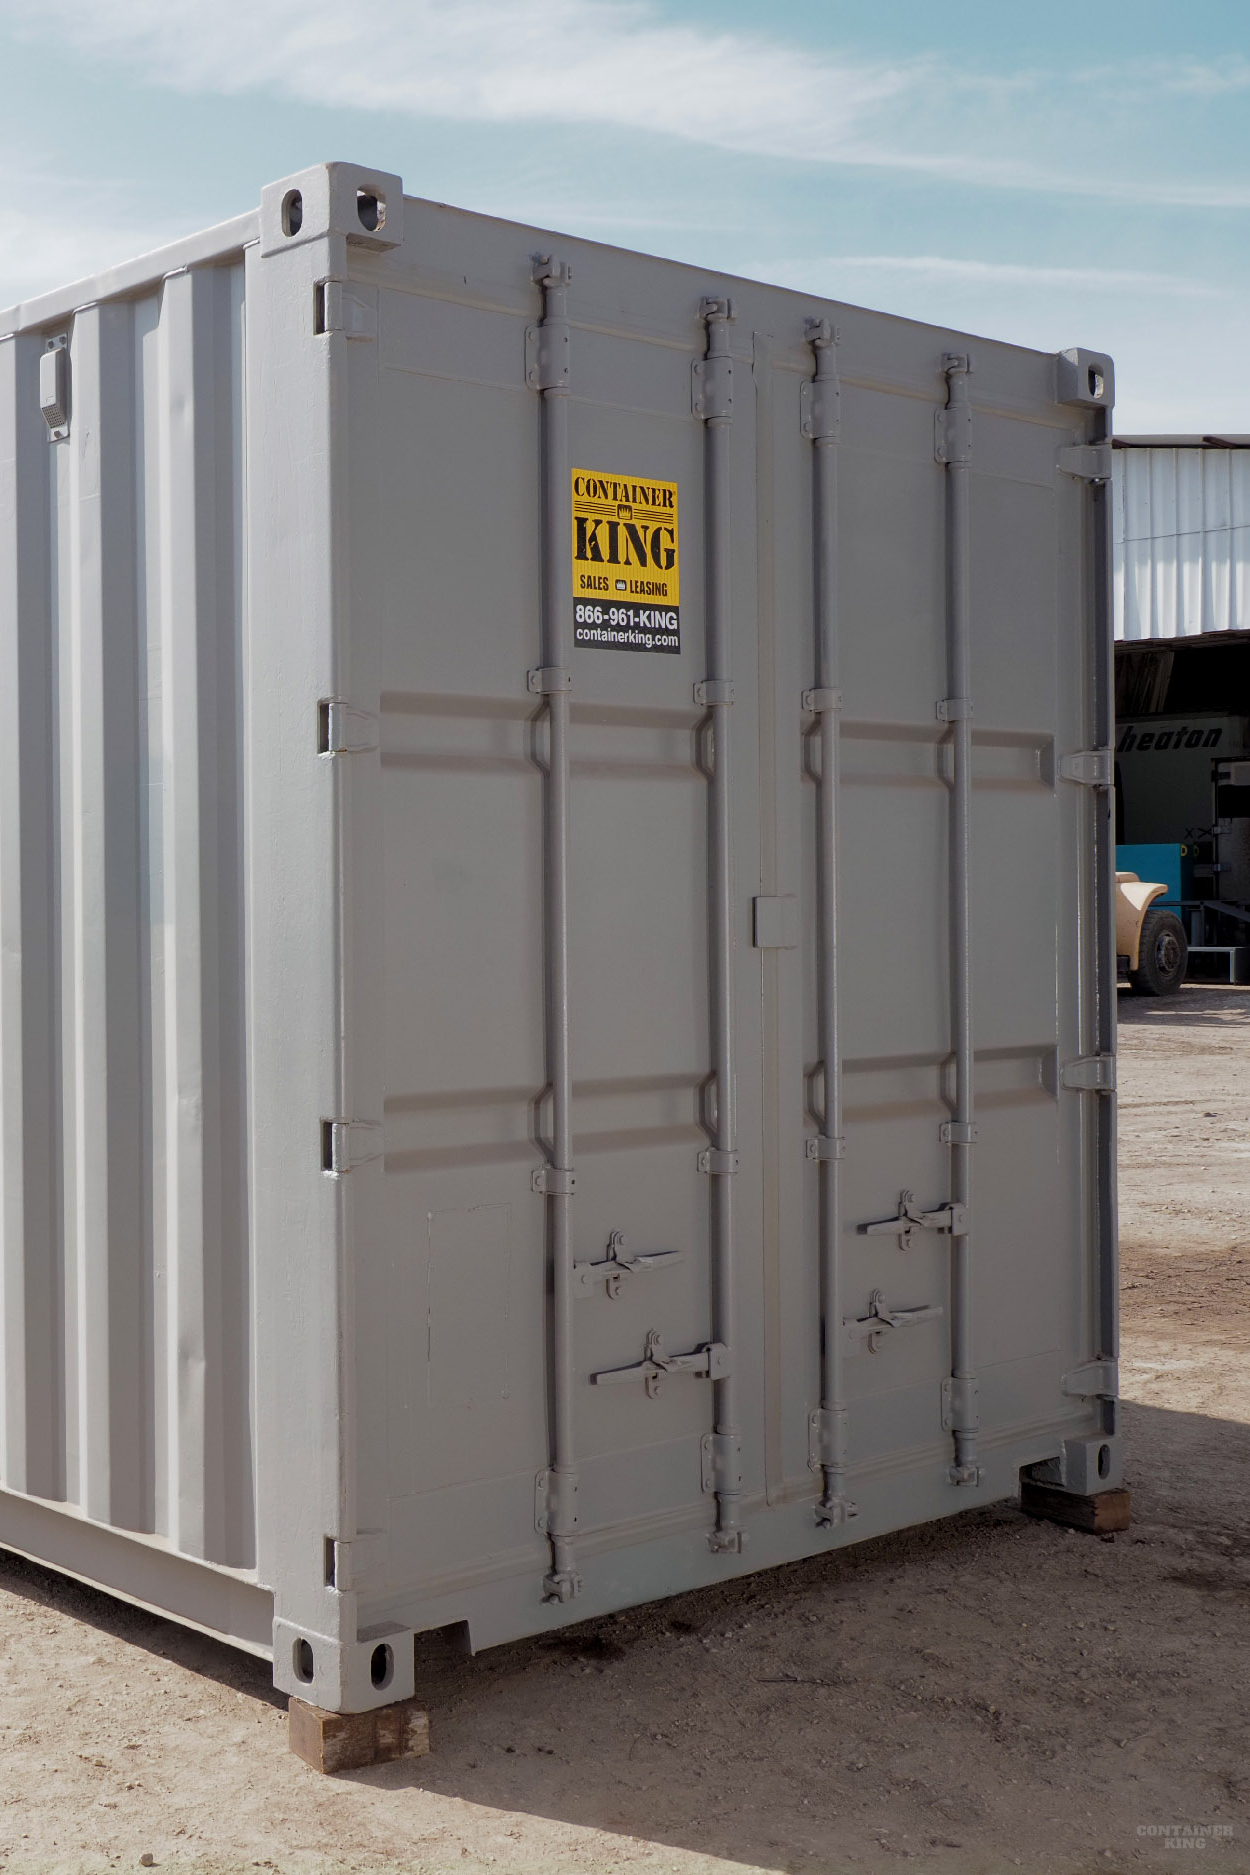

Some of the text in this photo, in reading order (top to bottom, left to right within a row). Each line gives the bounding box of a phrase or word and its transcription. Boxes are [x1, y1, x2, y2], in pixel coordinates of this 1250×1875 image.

[574, 476, 674, 509] CONTAINER
[574, 516, 676, 571] KING
[580, 574, 668, 597] SALES LEASING
[575, 604, 678, 630] 866-961-KING
[576, 627, 679, 648] containerking.com
[1116, 725, 1223, 752] heaton
